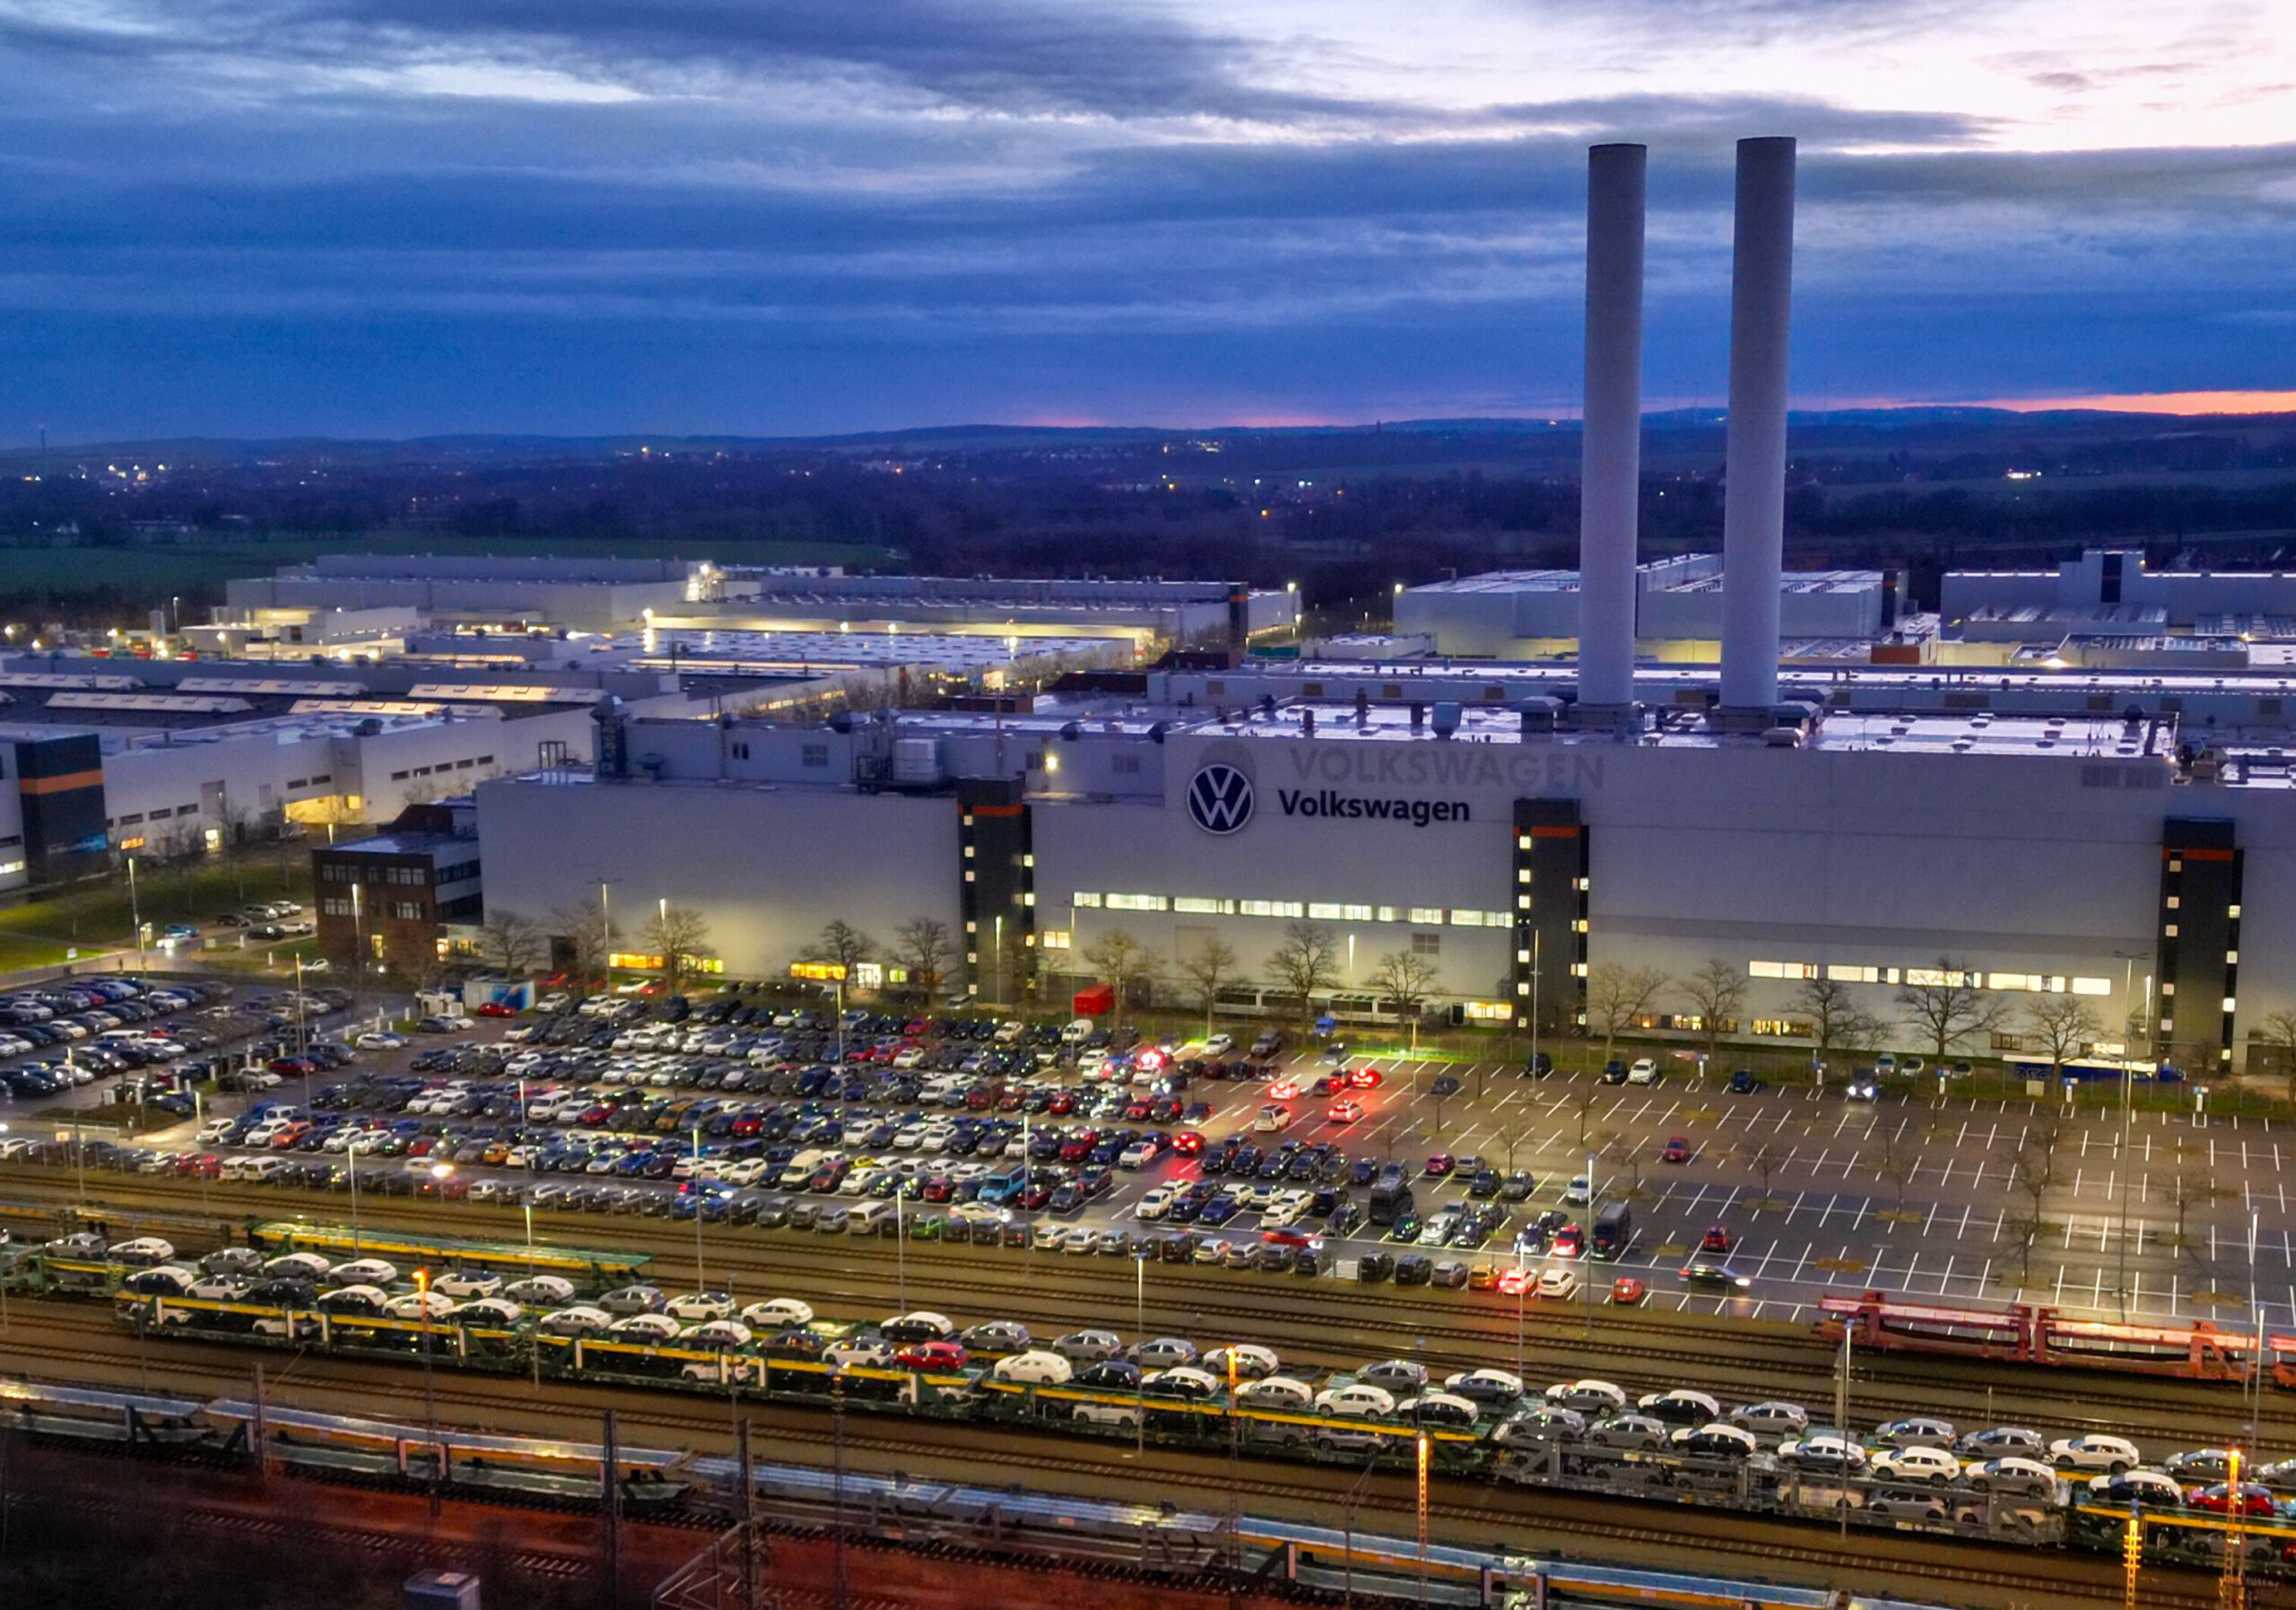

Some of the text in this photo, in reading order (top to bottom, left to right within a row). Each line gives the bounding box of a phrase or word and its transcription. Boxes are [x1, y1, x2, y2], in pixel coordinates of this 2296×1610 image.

[1290, 746, 1604, 790] VOLKSWAGEN
[1188, 765, 1254, 831] VW
[1278, 789, 1470, 827] Volkswagen
